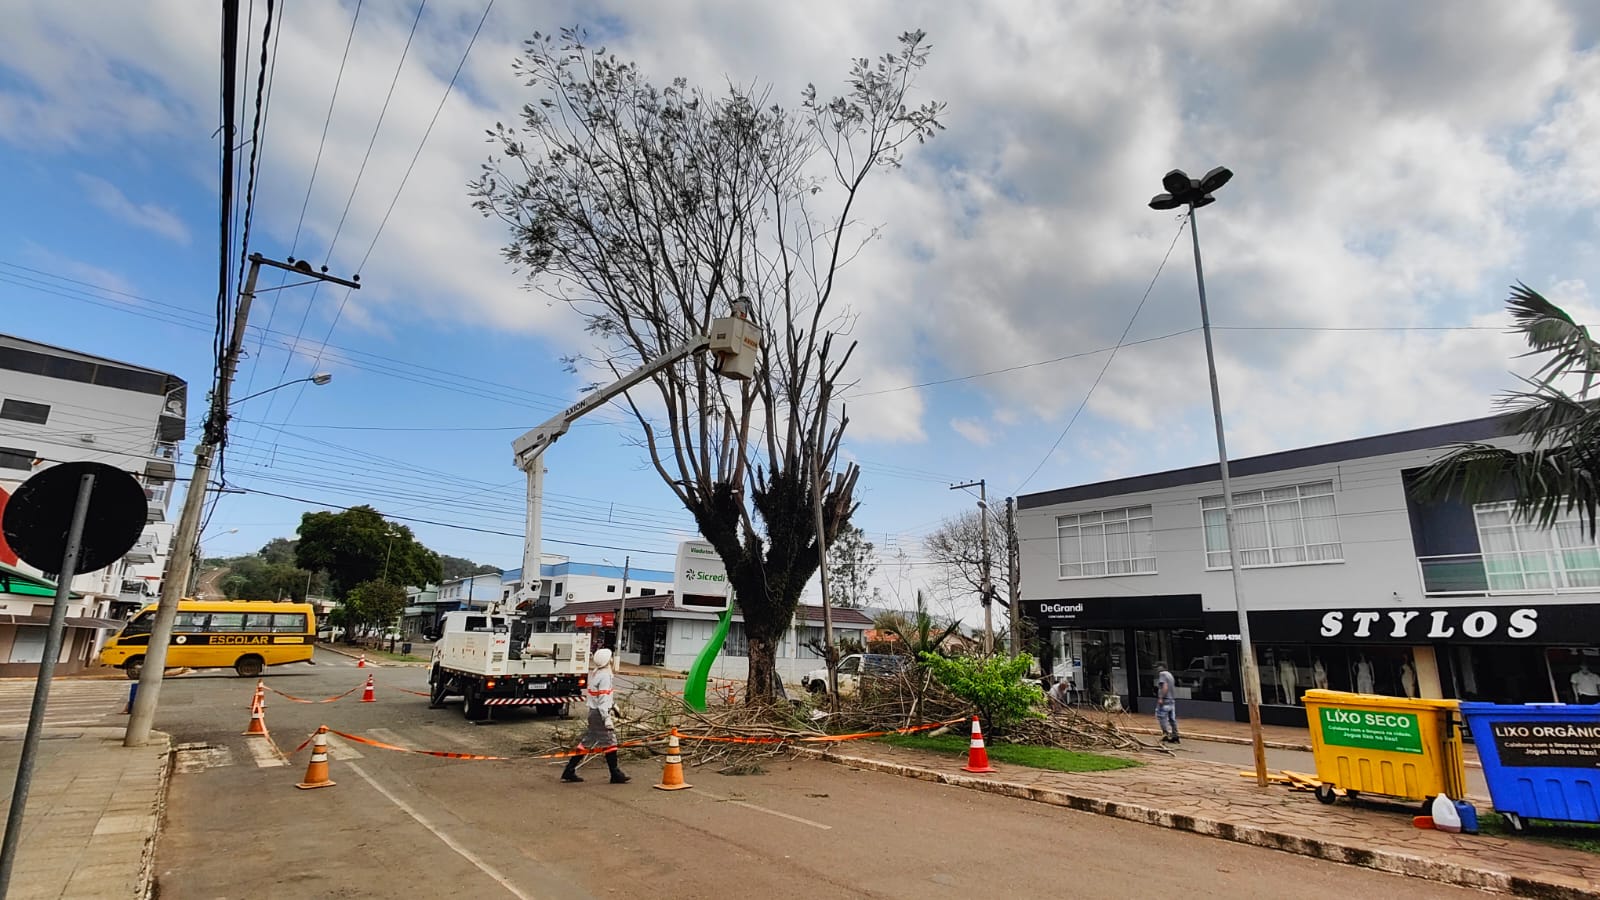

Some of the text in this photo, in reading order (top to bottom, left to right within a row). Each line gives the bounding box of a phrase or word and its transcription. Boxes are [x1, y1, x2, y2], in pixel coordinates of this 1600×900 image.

[565, 400, 586, 417] AXION
[696, 571, 726, 583] Sicredi
[1320, 608, 1538, 638] STYLOS
[208, 635, 269, 645] ESCOLAR
[1365, 713, 1410, 728] SECO
[1495, 727, 1529, 737] LIXO
